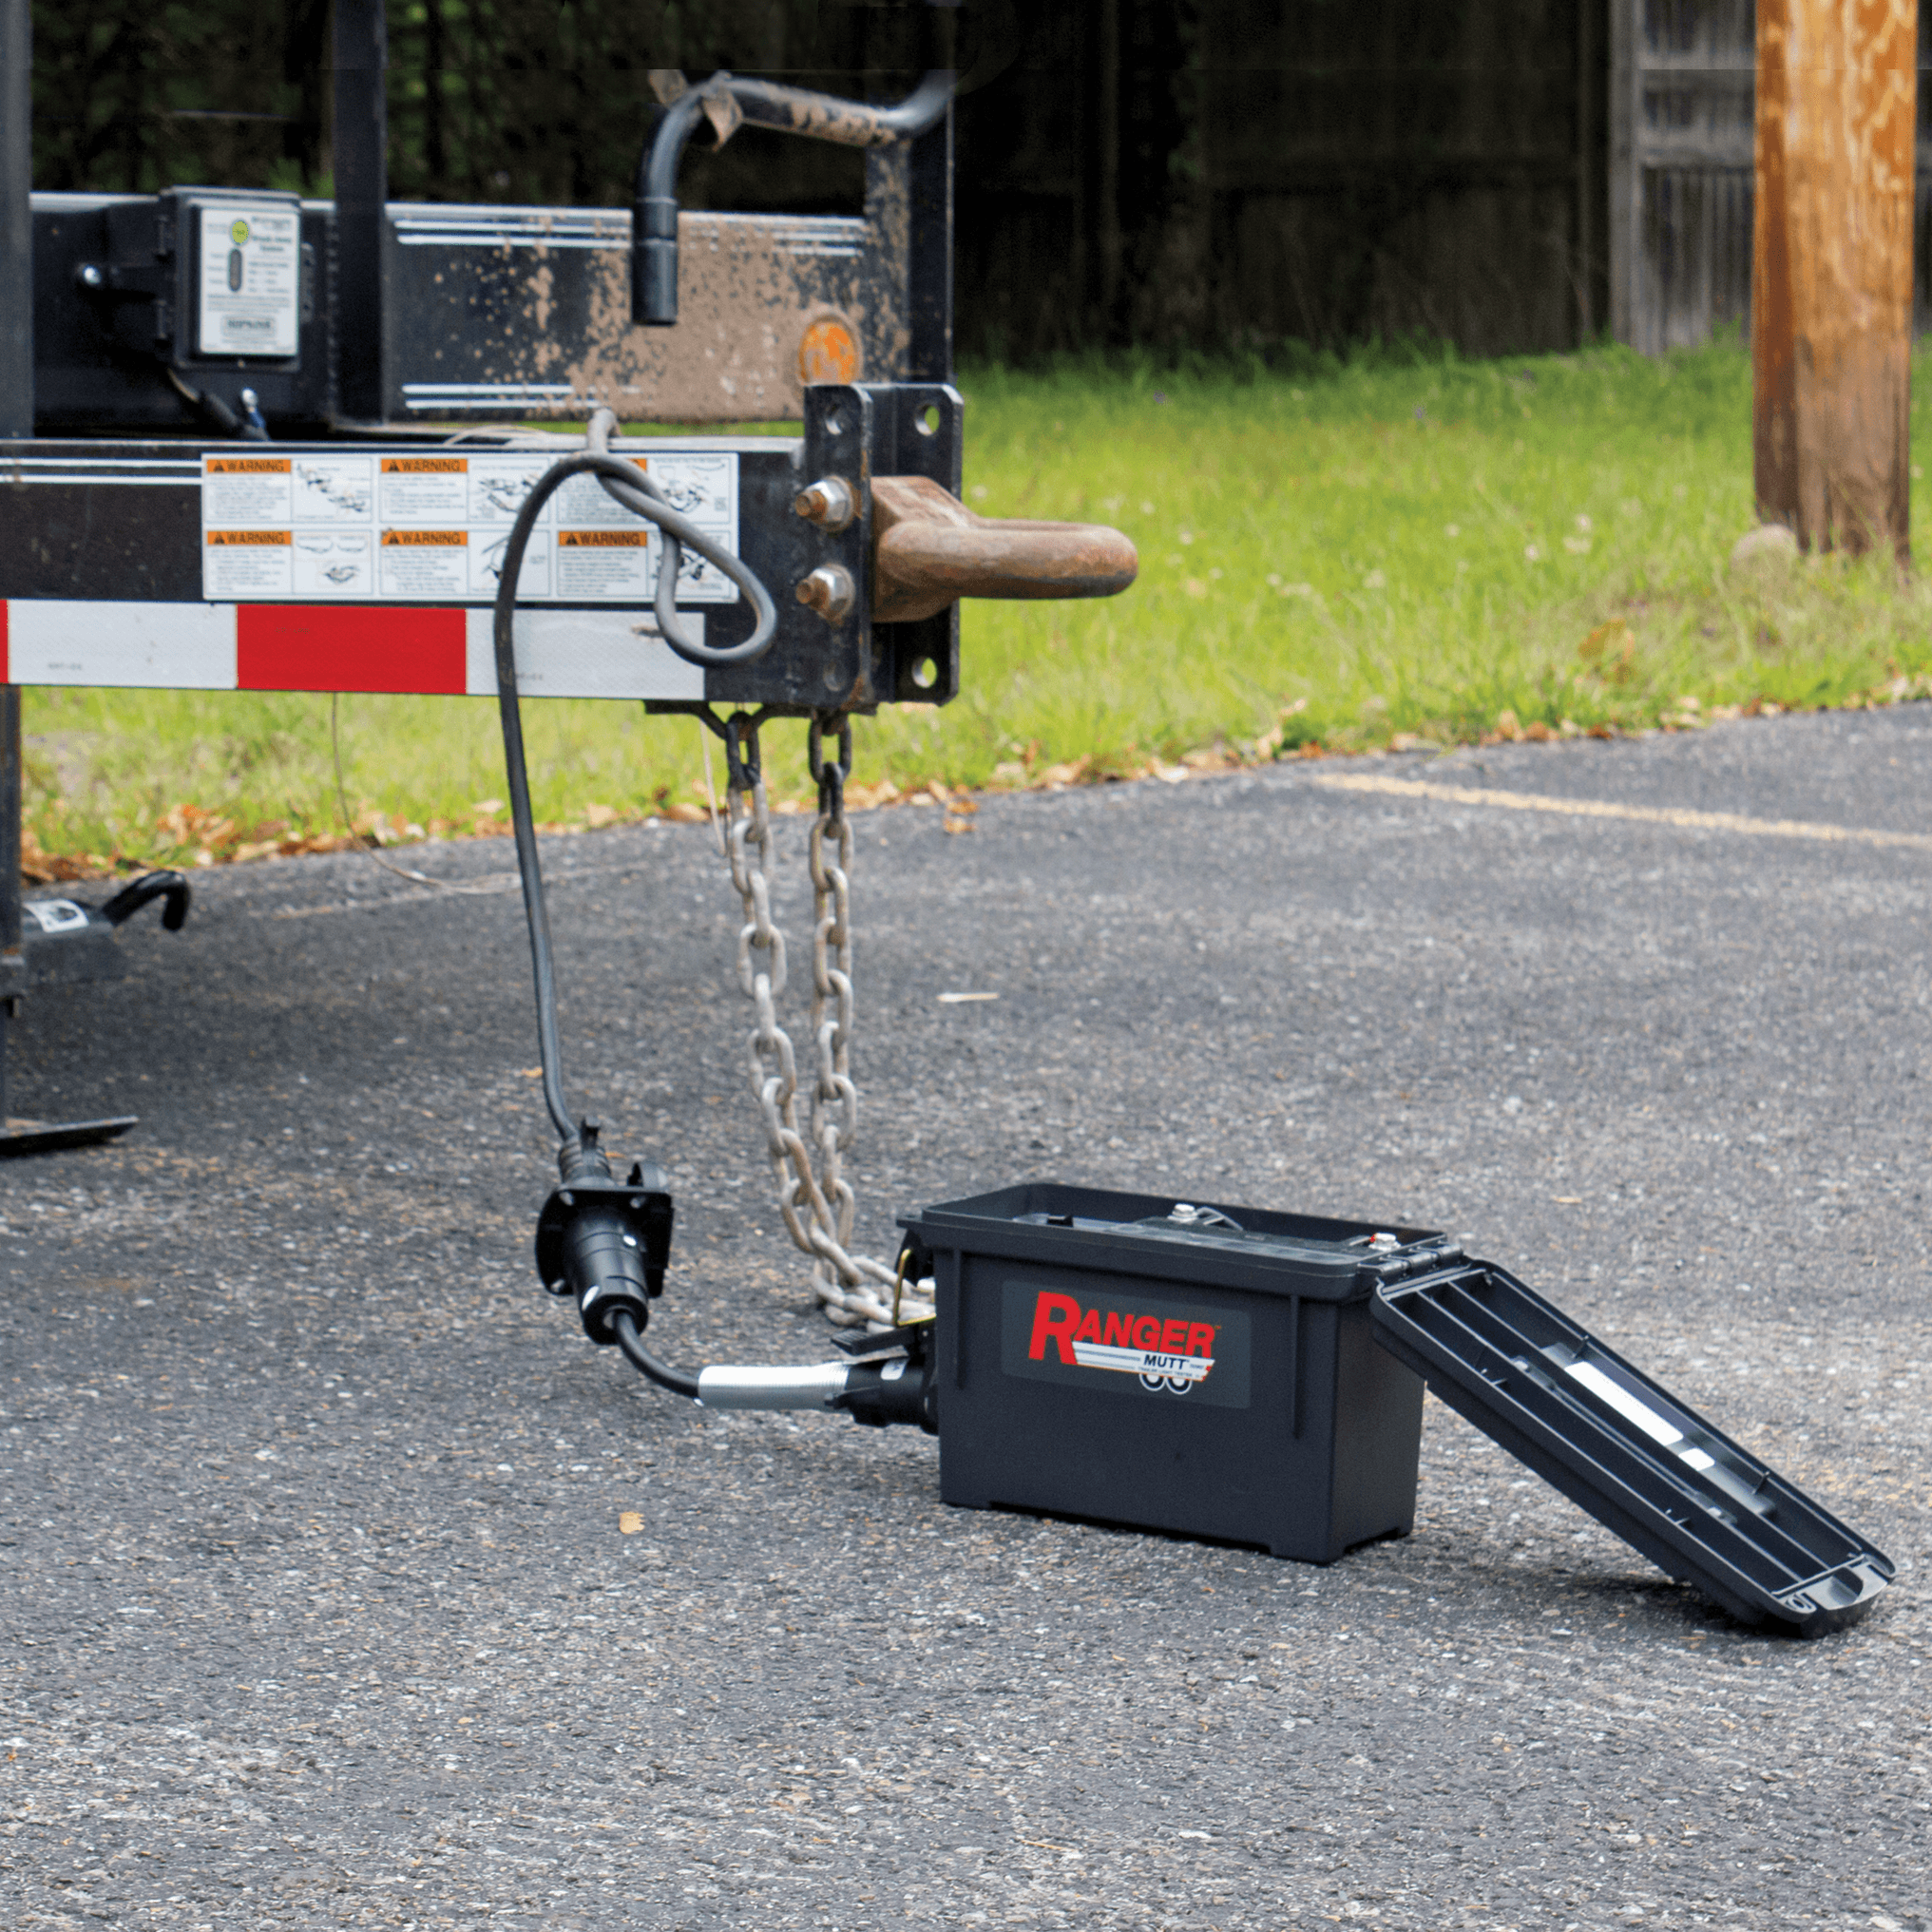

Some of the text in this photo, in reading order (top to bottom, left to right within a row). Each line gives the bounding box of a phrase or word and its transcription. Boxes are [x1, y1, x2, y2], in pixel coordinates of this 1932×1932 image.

[228, 460, 284, 471] WARNING
[402, 460, 460, 471] WARNING
[228, 532, 284, 544] WARNING
[402, 532, 461, 545] WARNING
[580, 532, 641, 545] WARNING
[1028, 1291, 1215, 1366] RANGER
[1144, 1354, 1187, 1369] MUTT
